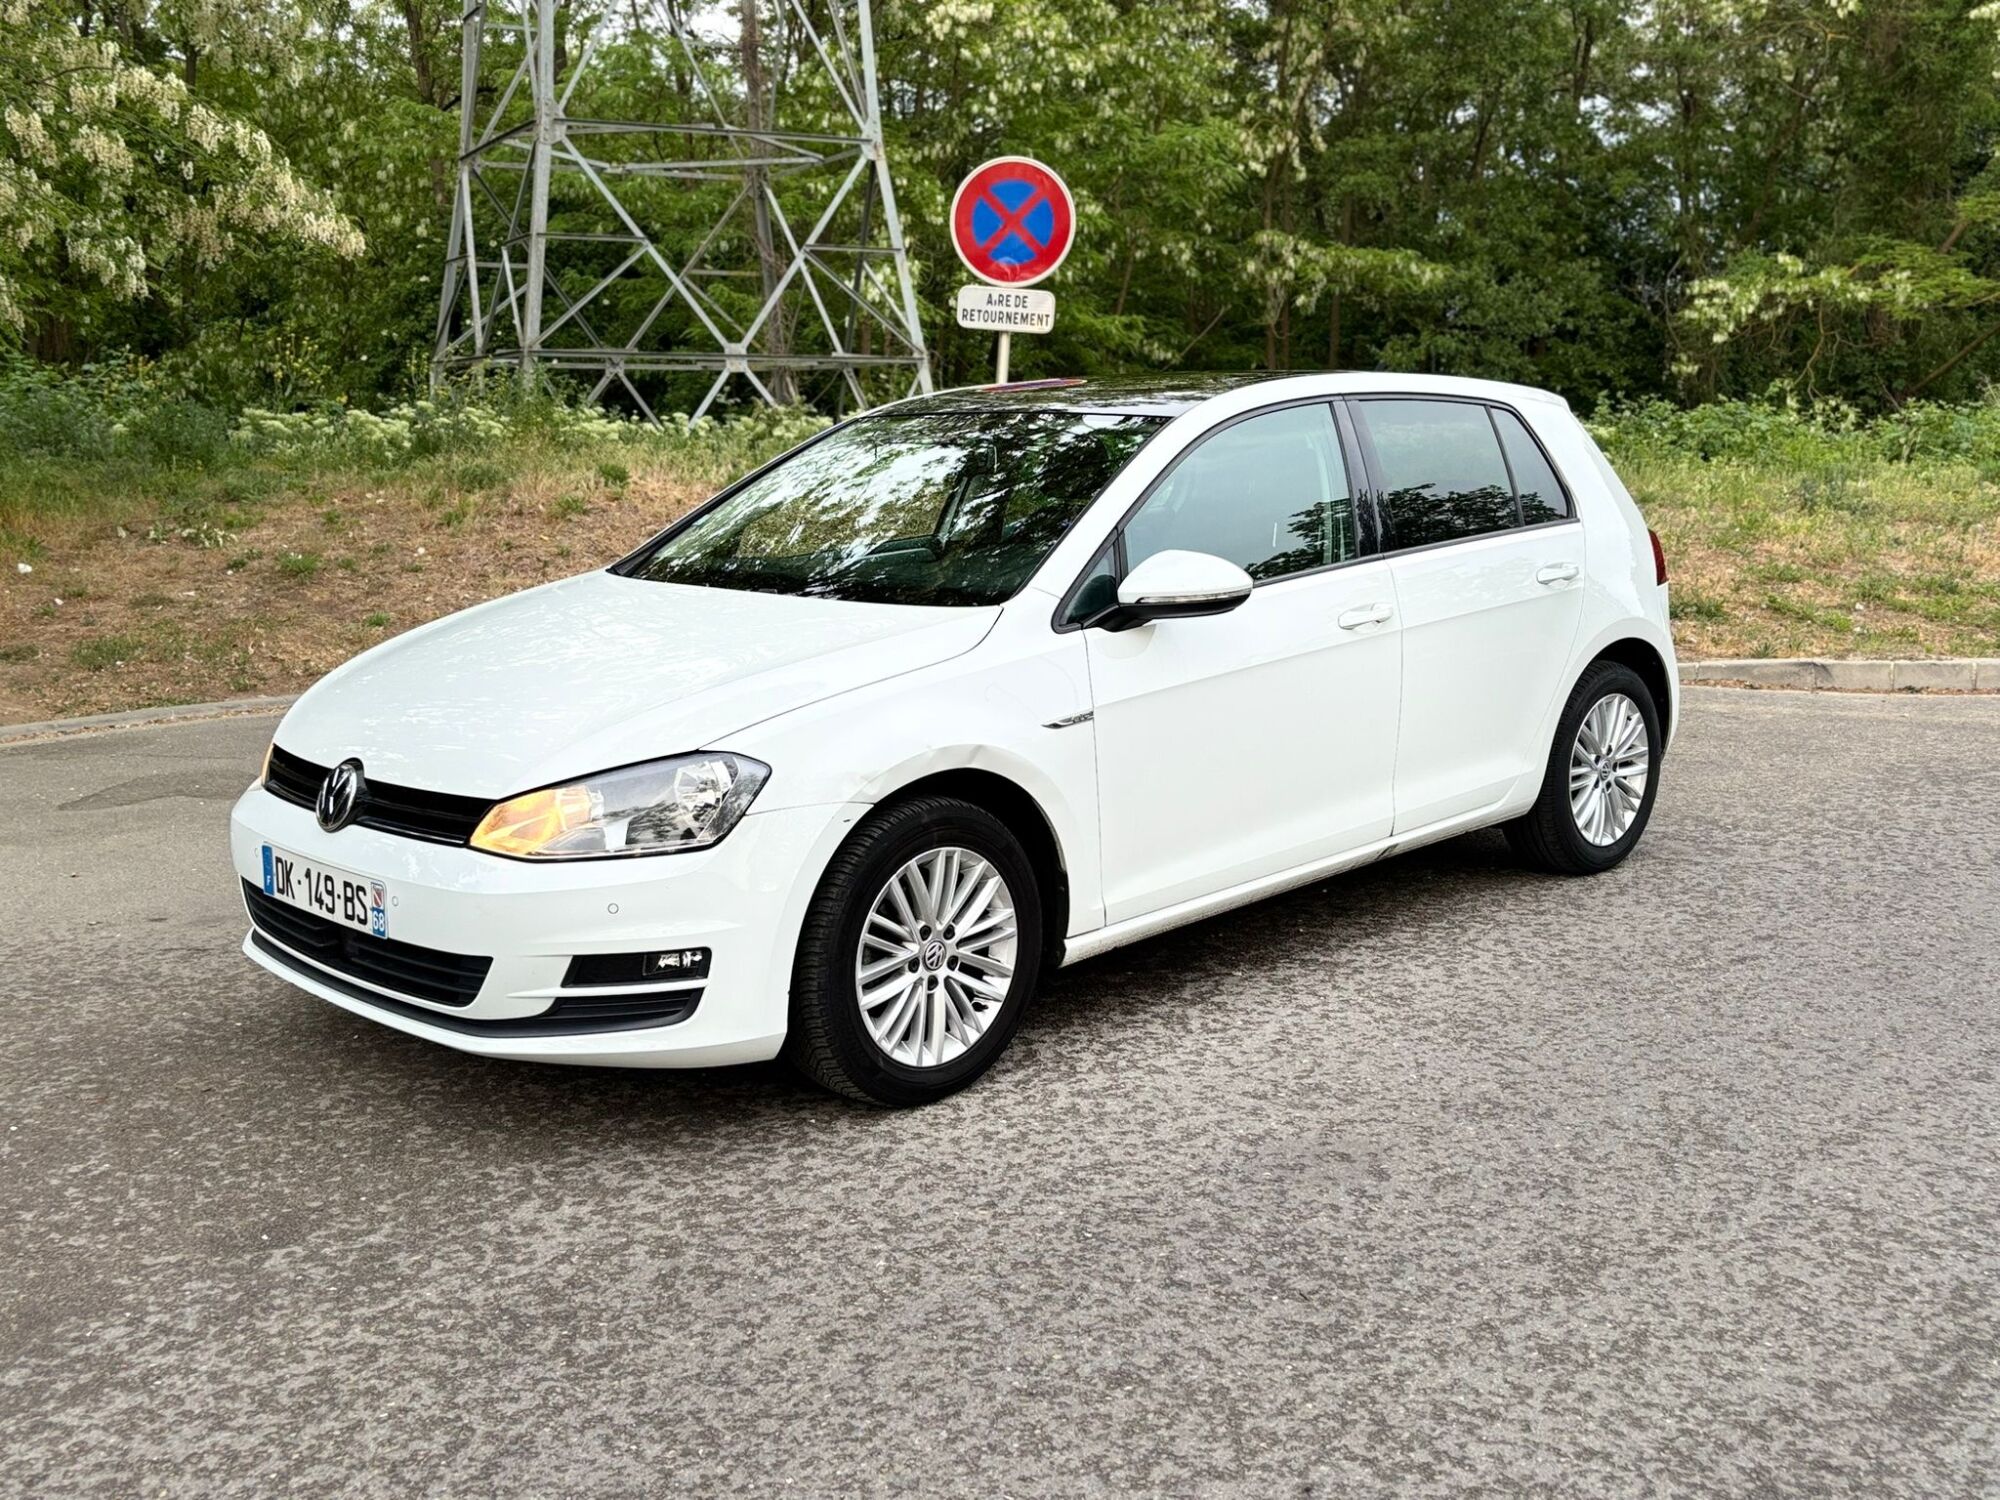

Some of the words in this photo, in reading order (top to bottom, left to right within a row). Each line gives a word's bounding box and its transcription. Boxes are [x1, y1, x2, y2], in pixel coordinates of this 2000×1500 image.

[1014, 295, 1028, 309] DE
[962, 308, 1050, 327] RETOURNEMENT
[373, 911, 385, 932] 68
